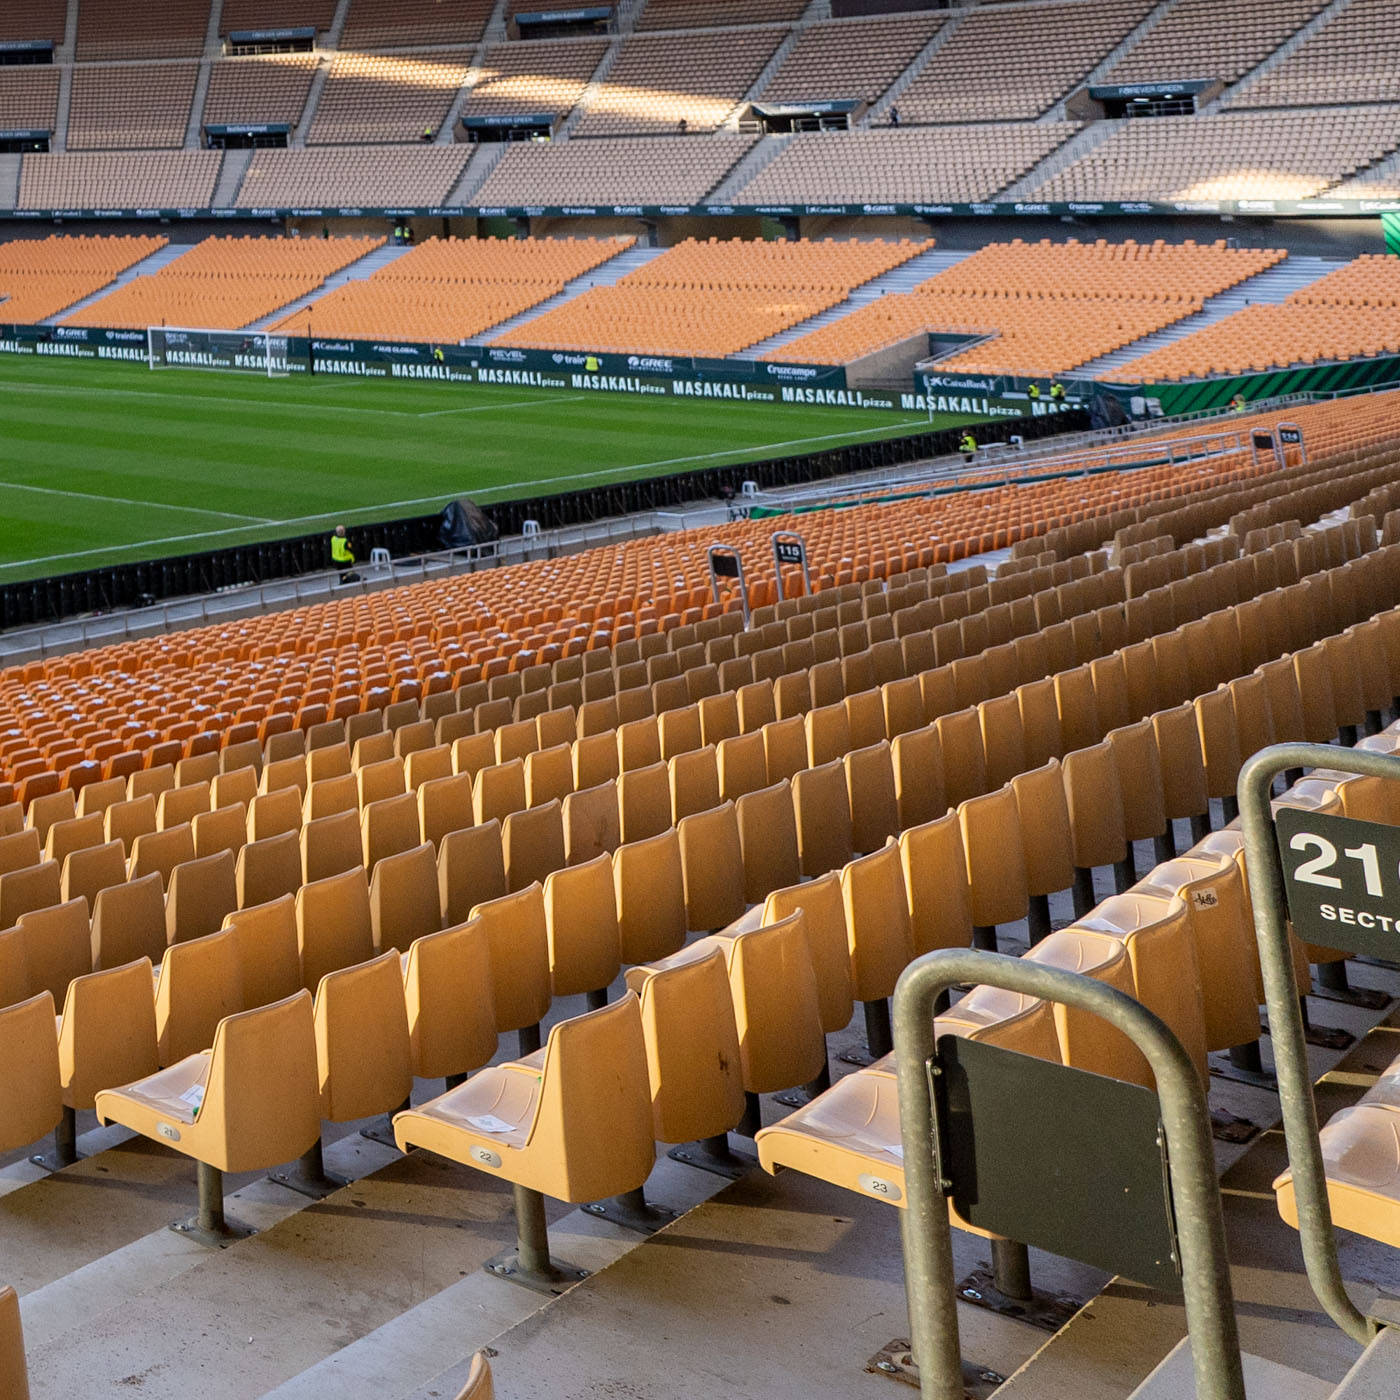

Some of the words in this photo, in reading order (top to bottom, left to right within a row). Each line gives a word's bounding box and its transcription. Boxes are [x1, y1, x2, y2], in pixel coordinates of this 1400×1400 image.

[37, 342, 79, 356] MASAKALI
[98, 345, 144, 360] MASAKALI
[489, 349, 526, 358] REVEL
[286, 361, 305, 372] pizza
[641, 358, 673, 368] GREE
[365, 367, 386, 377] pizza
[392, 362, 450, 379] MASAKALI
[450, 371, 472, 382] pizza
[478, 368, 542, 386] MASAKALI
[541, 376, 565, 387] pizza
[767, 364, 817, 377] Cruzcampo
[571, 374, 640, 392] MASAKALI
[640, 382, 665, 394] pizza
[673, 380, 747, 399] MASAKALI
[747, 390, 774, 402] pizza
[942, 378, 988, 390] CaixaBank
[782, 386, 863, 406] MASAKALI
[863, 395, 893, 408] pizza
[901, 393, 989, 414] MASAKALI
[989, 403, 1023, 417] pizza
[778, 544, 800, 557] 115
[1289, 833, 1400, 898] 21
[164, 1127, 173, 1137] 21
[480, 1151, 492, 1162] 22
[872, 1180, 888, 1194] 23
